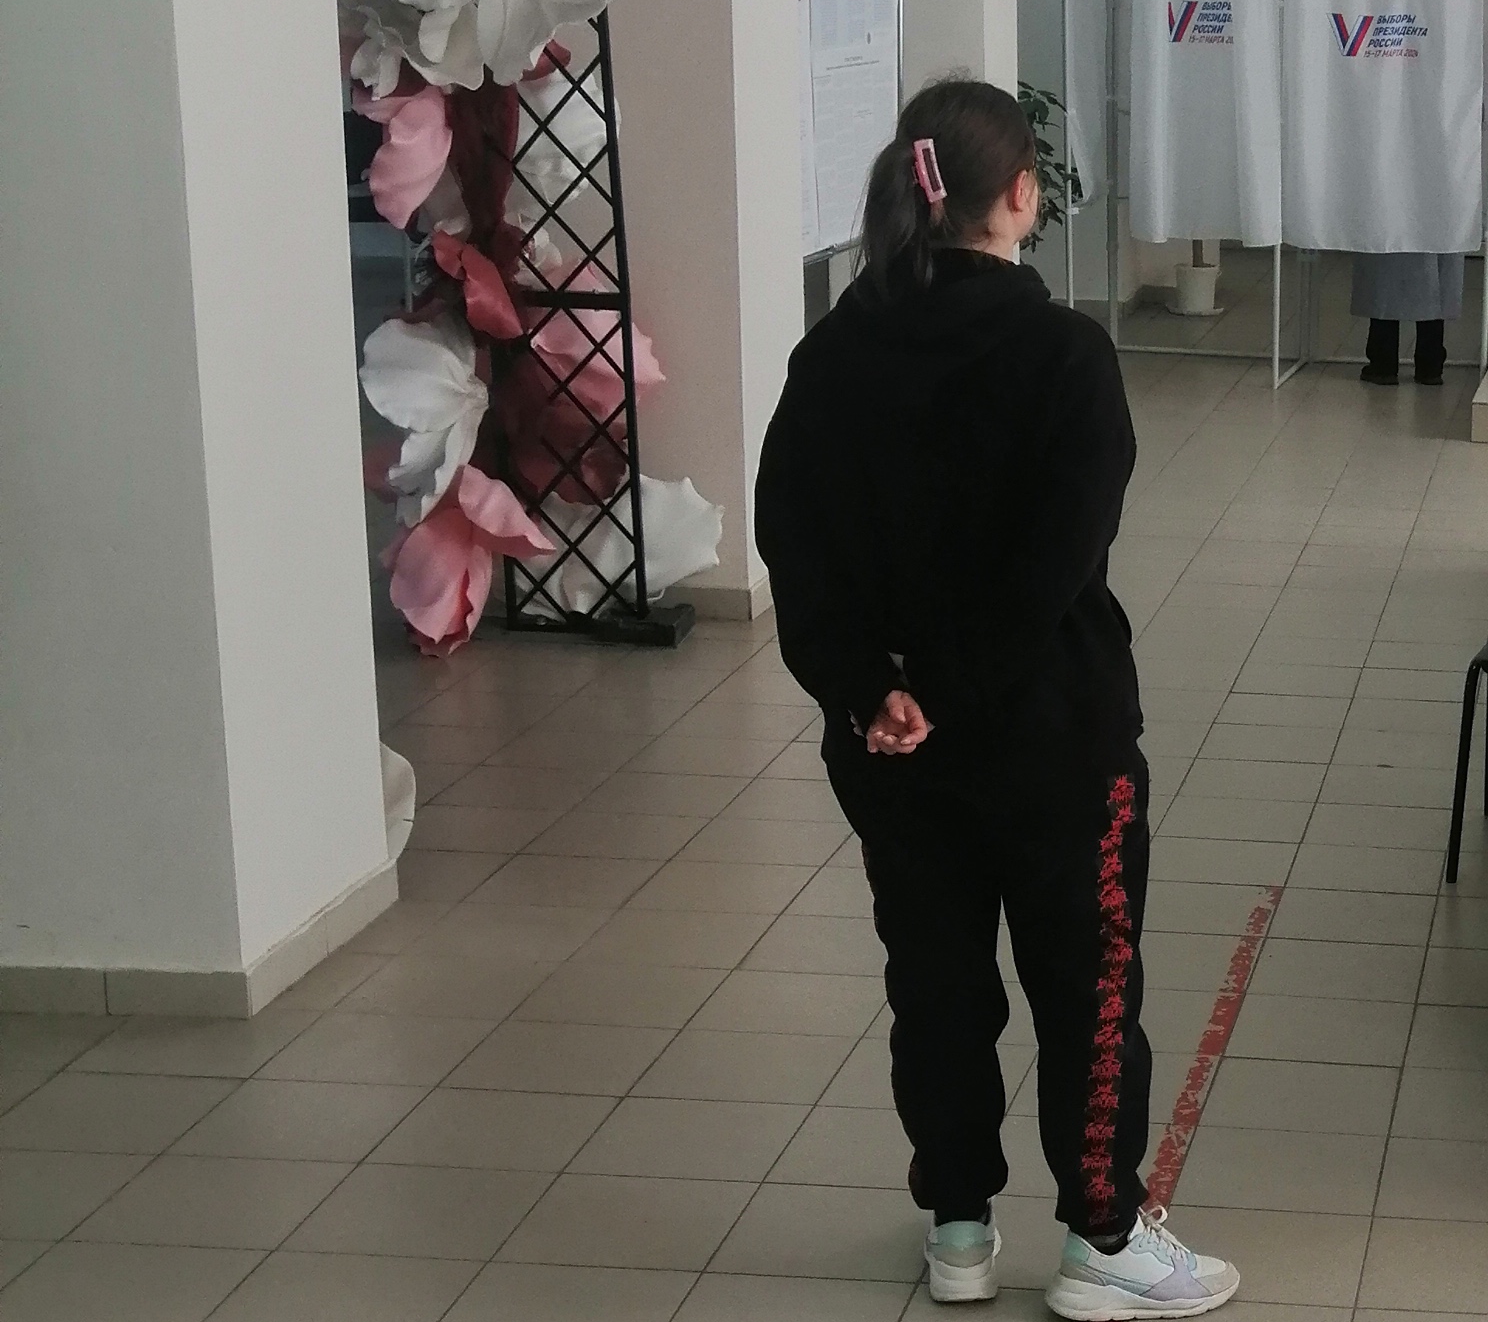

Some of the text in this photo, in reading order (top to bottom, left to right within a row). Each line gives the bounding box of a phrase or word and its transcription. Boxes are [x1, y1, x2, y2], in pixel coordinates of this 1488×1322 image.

[1376, 15, 1416, 25] ВЫБОРЫ
[1192, 24, 1225, 34] РОССИИ
[1372, 26, 1429, 37] ПРЕЗИДЕНТА
[1367, 38, 1403, 48] РОССИИ
